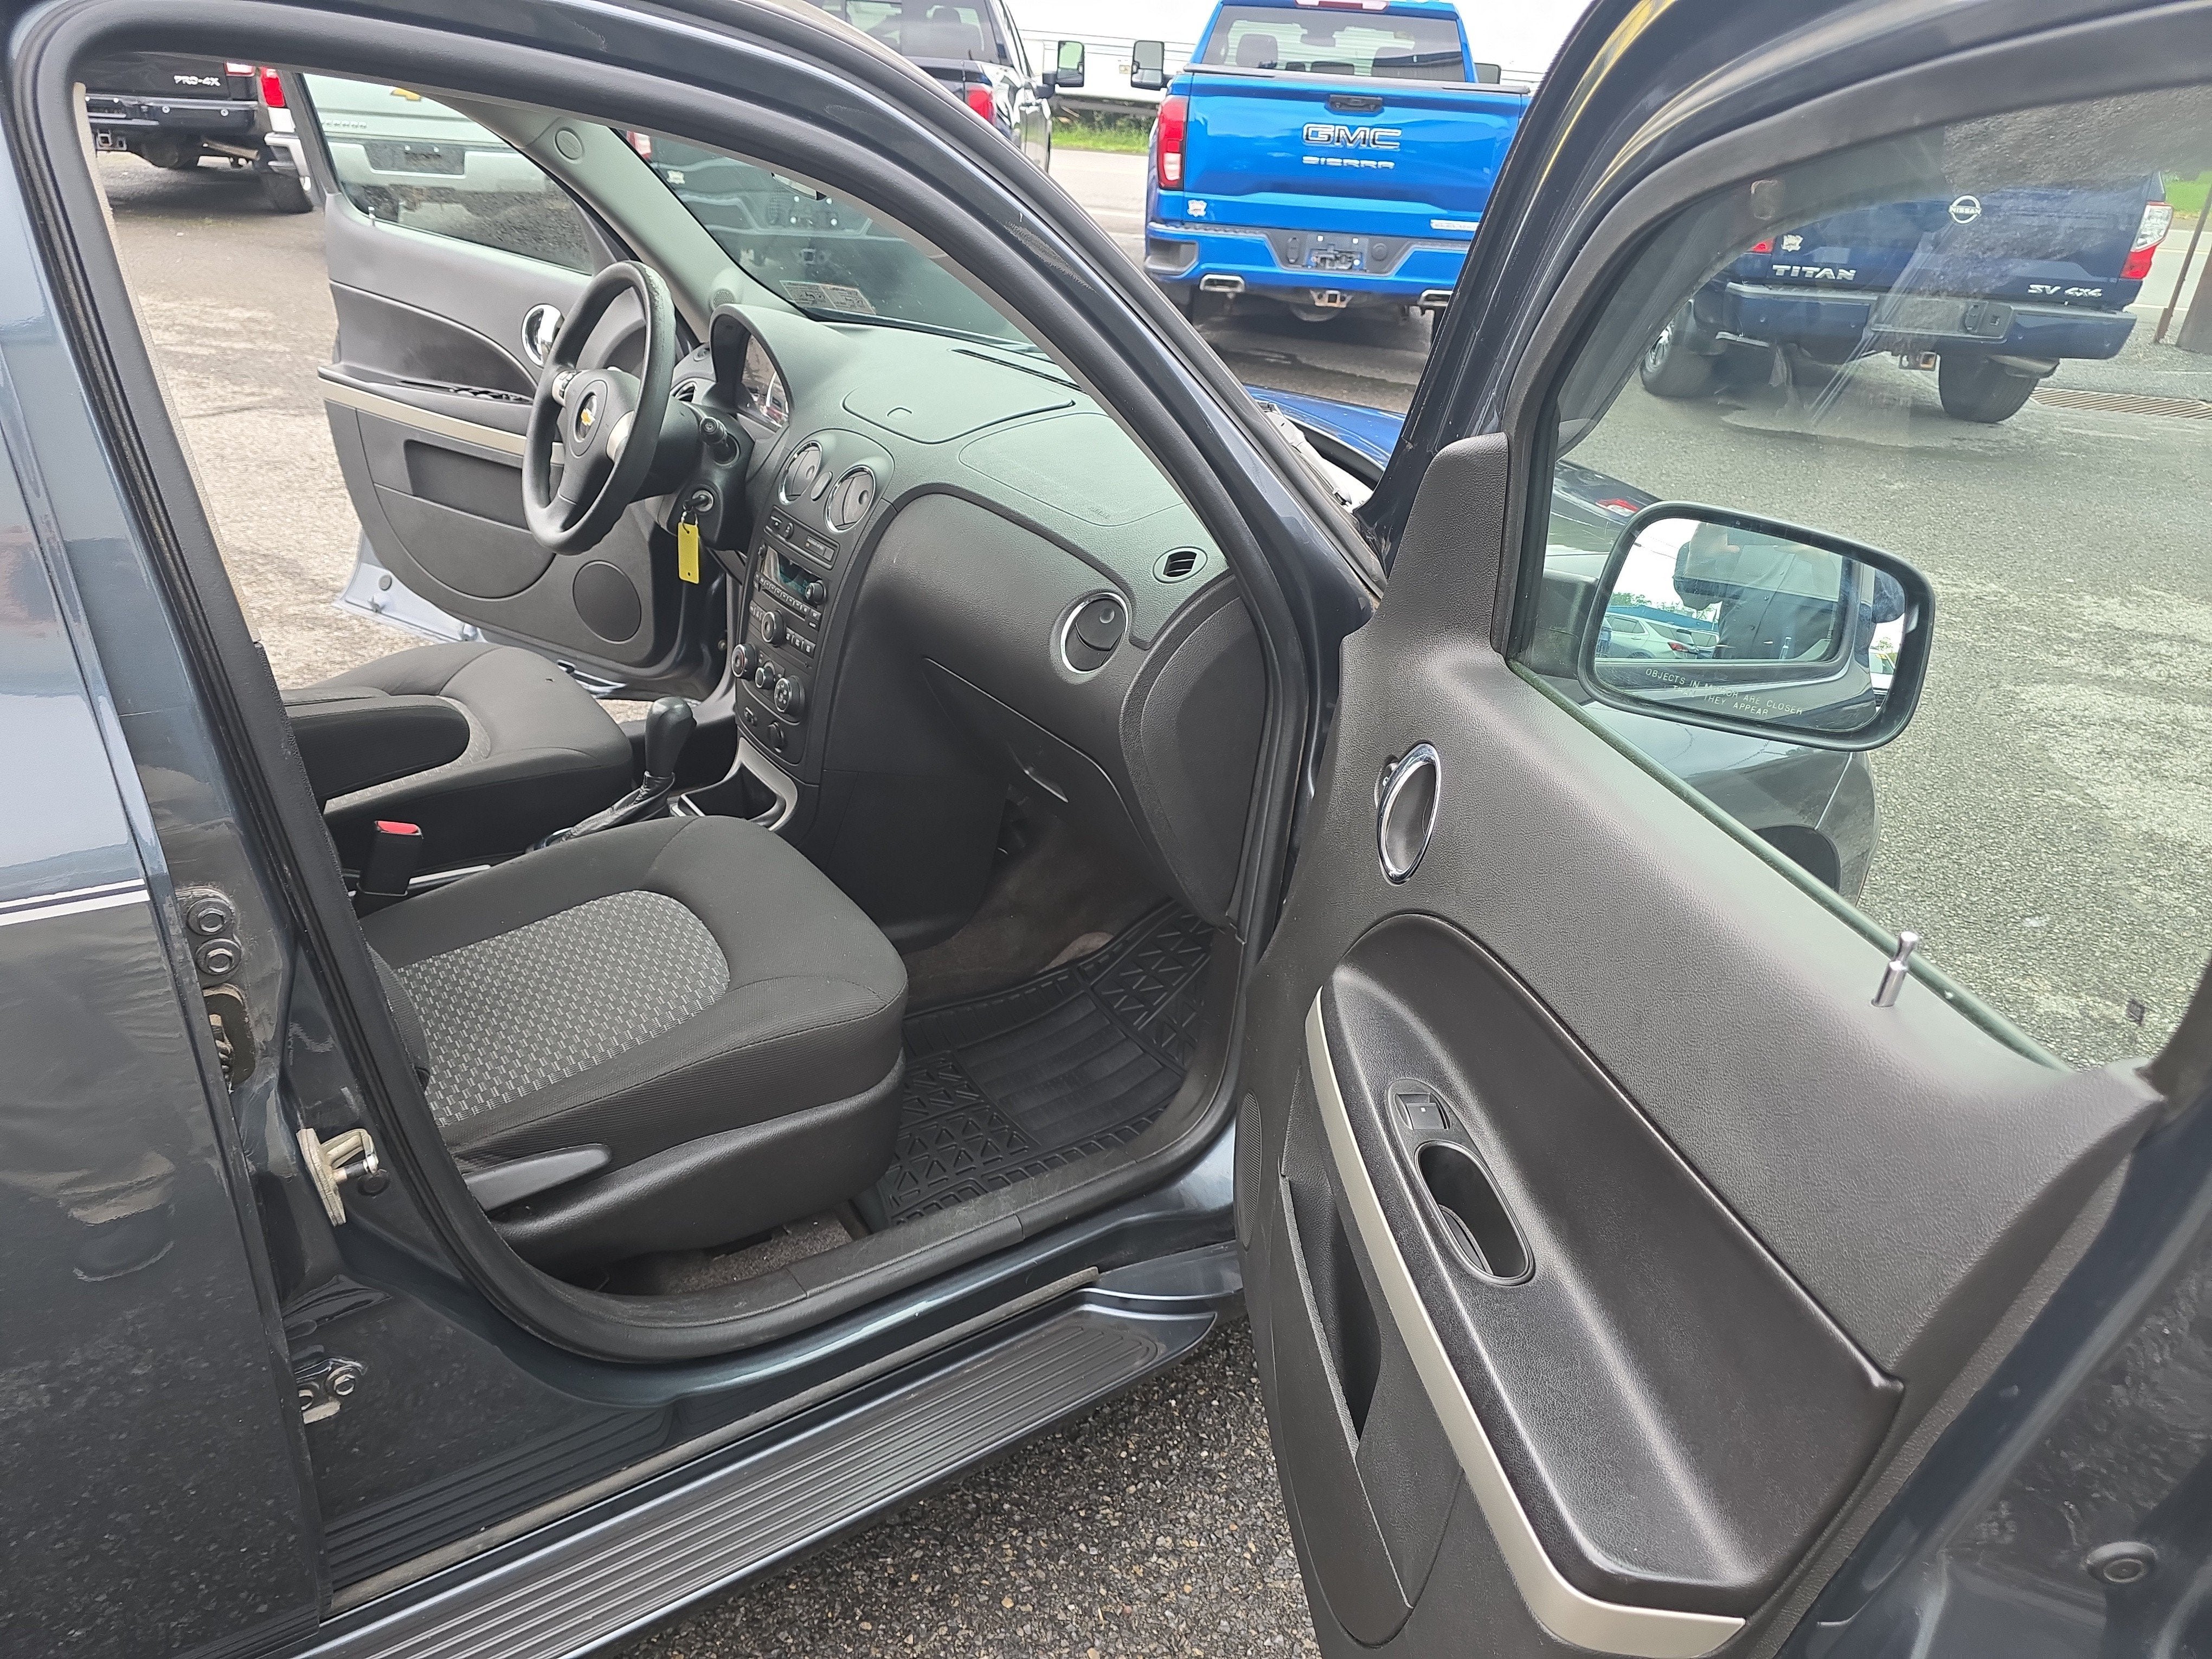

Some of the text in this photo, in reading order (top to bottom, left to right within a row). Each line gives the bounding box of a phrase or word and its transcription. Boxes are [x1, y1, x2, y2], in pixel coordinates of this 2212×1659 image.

[1303, 124, 1402, 149] GMC
[1302, 156, 1395, 169] SIERRA
[1949, 205, 1982, 215] NISSAN
[1772, 265, 1856, 280] TITAN
[2028, 284, 2061, 294] SV
[1645, 668, 1686, 685] OBJECTS
[1689, 679, 1700, 688] IN
[1742, 695, 1761, 705] ARE
[1766, 700, 1803, 716] CLOSER
[1703, 693, 1727, 705] THEY
[1732, 702, 1769, 716] APPEAR
